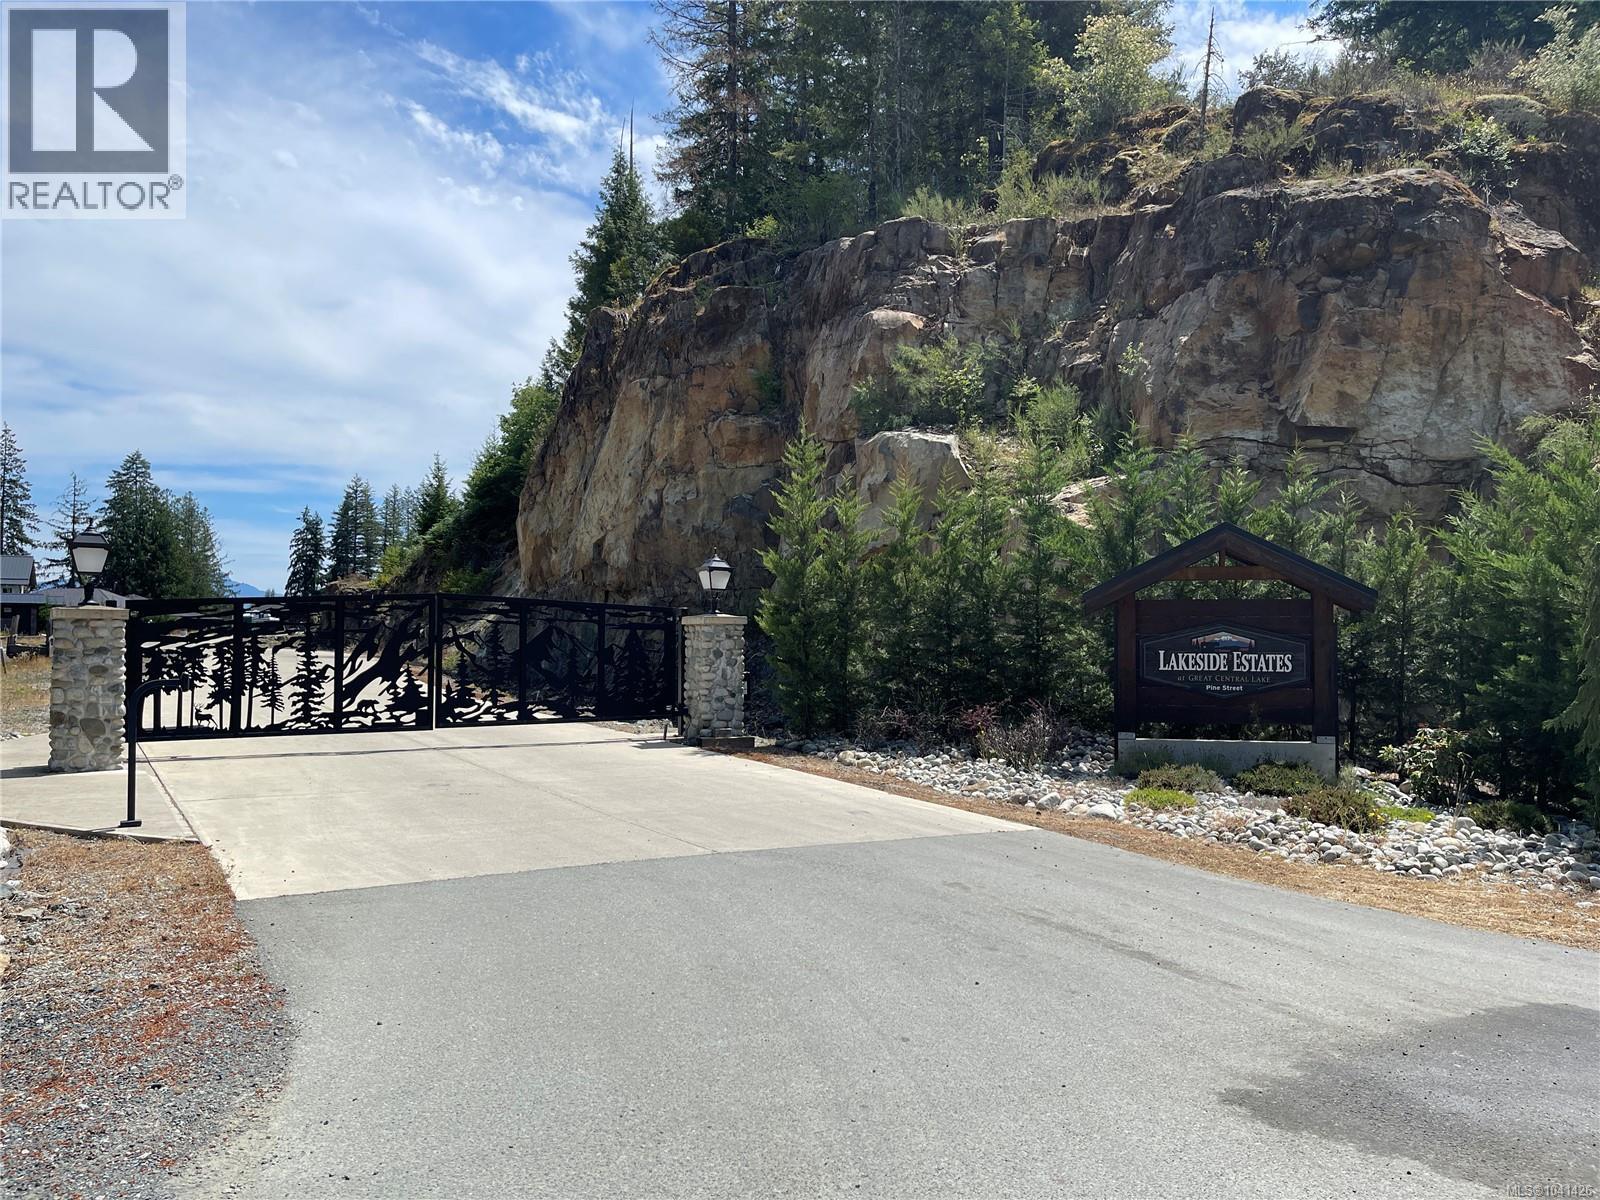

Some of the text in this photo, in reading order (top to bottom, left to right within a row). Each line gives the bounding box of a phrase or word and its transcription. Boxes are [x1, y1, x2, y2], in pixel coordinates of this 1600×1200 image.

[1158, 650, 1293, 673] LAKESIDE ESTATES
[1188, 674, 1212, 682] GREAT
[1214, 674, 1249, 683] CENTRAL
[1251, 675, 1271, 683] LAKE
